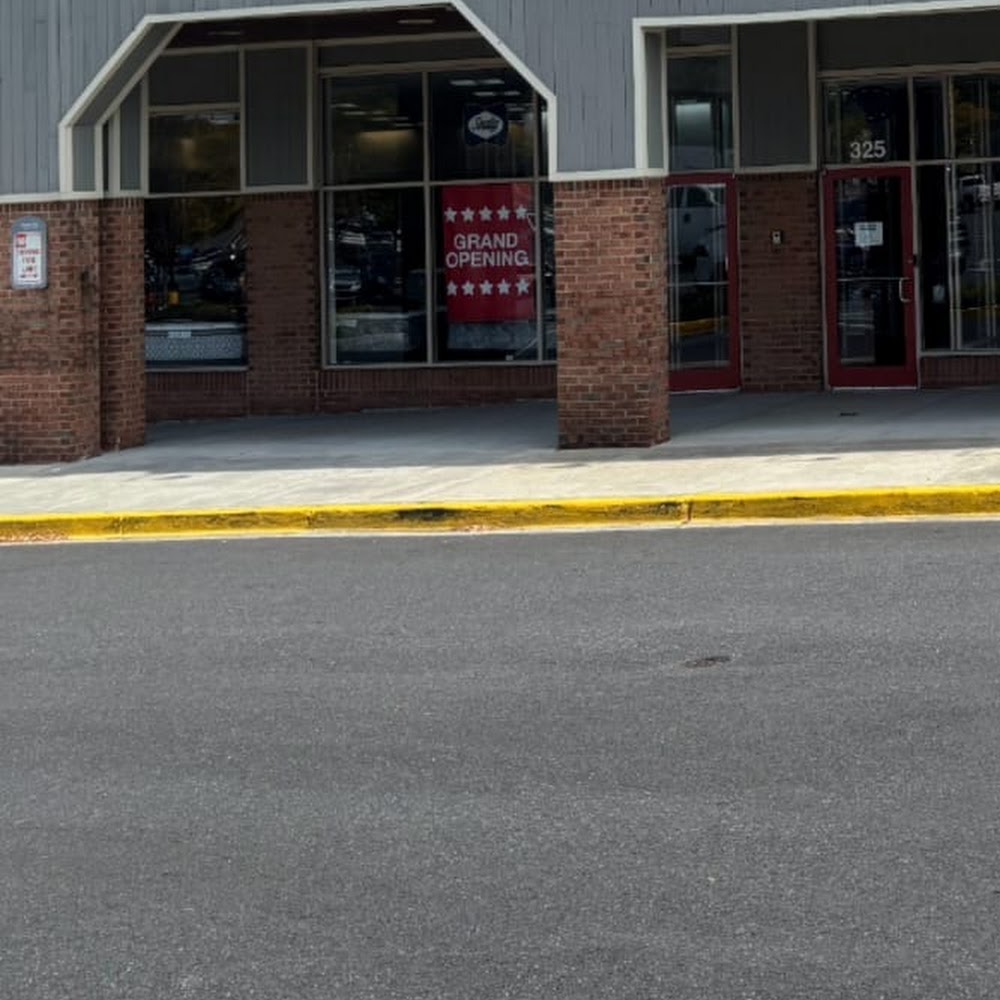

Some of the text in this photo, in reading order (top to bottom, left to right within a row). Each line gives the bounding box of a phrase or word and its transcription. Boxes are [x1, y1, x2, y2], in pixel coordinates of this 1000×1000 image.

[850, 140, 886, 159] 325
[453, 232, 518, 250] GRAND
[446, 250, 529, 268] OPENING
